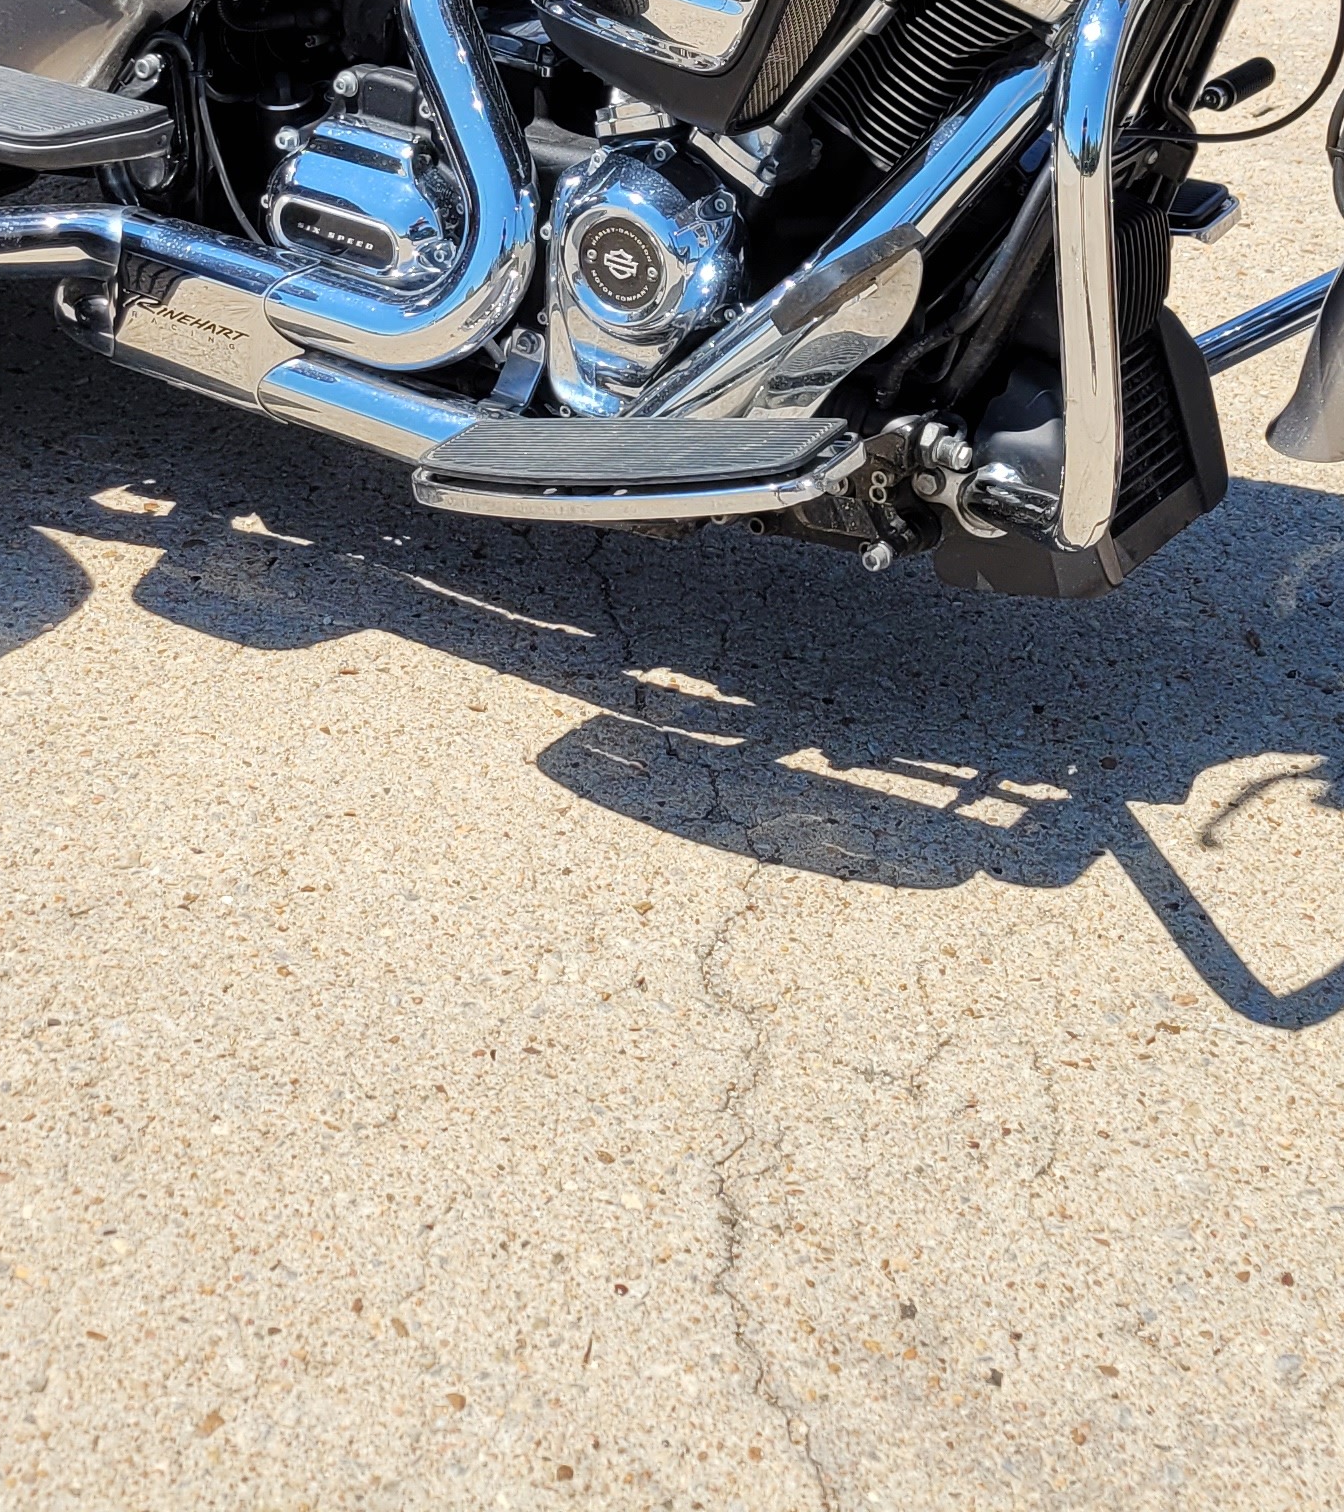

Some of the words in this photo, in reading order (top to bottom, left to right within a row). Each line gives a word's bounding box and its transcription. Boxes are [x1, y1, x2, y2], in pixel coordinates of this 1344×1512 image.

[297, 222, 320, 234] SIX
[328, 232, 373, 250] SPEED
[592, 227, 652, 263] HARLEY-DAVIDSON
[591, 270, 613, 296] MOTOR
[616, 285, 648, 302] COMPANY
[122, 288, 250, 341] RINEHART
